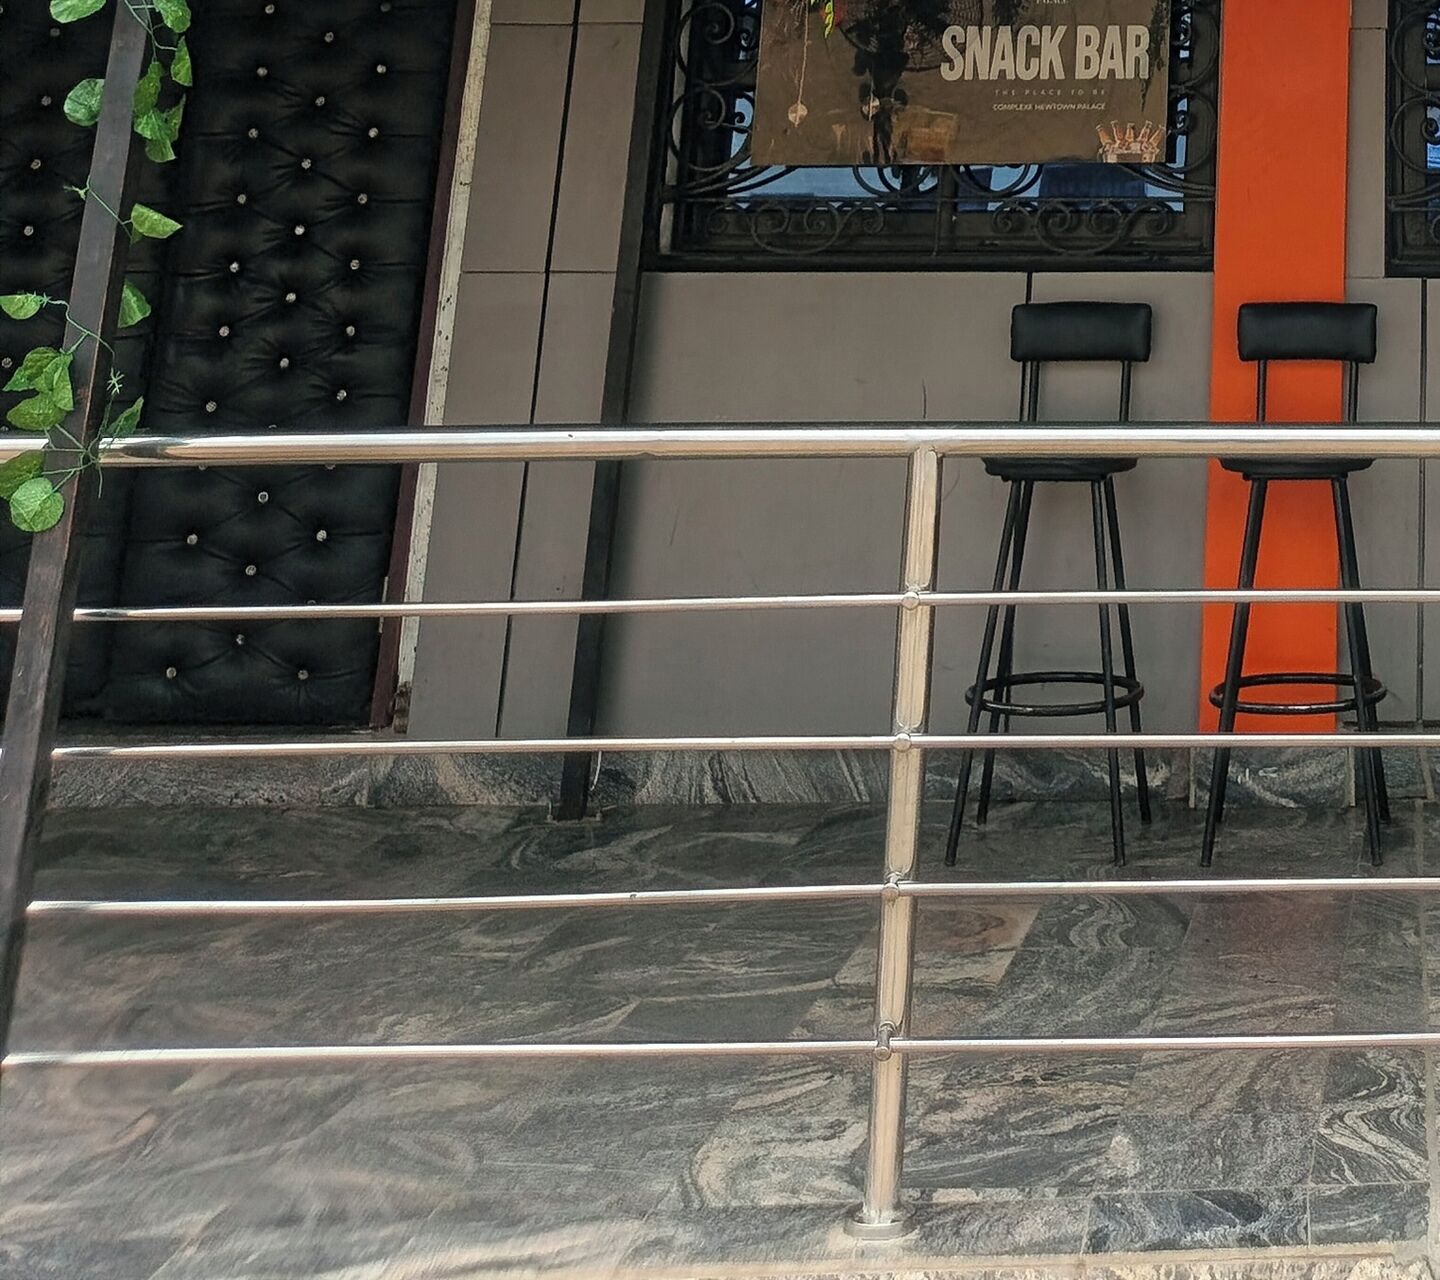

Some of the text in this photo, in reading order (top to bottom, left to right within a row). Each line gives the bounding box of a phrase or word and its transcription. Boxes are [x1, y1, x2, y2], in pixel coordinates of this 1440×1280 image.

[940, 24, 1150, 81] SNACK BAR
[995, 88, 1105, 96] THE PLACE TO BE
[1077, 102, 1106, 110] PALACE
